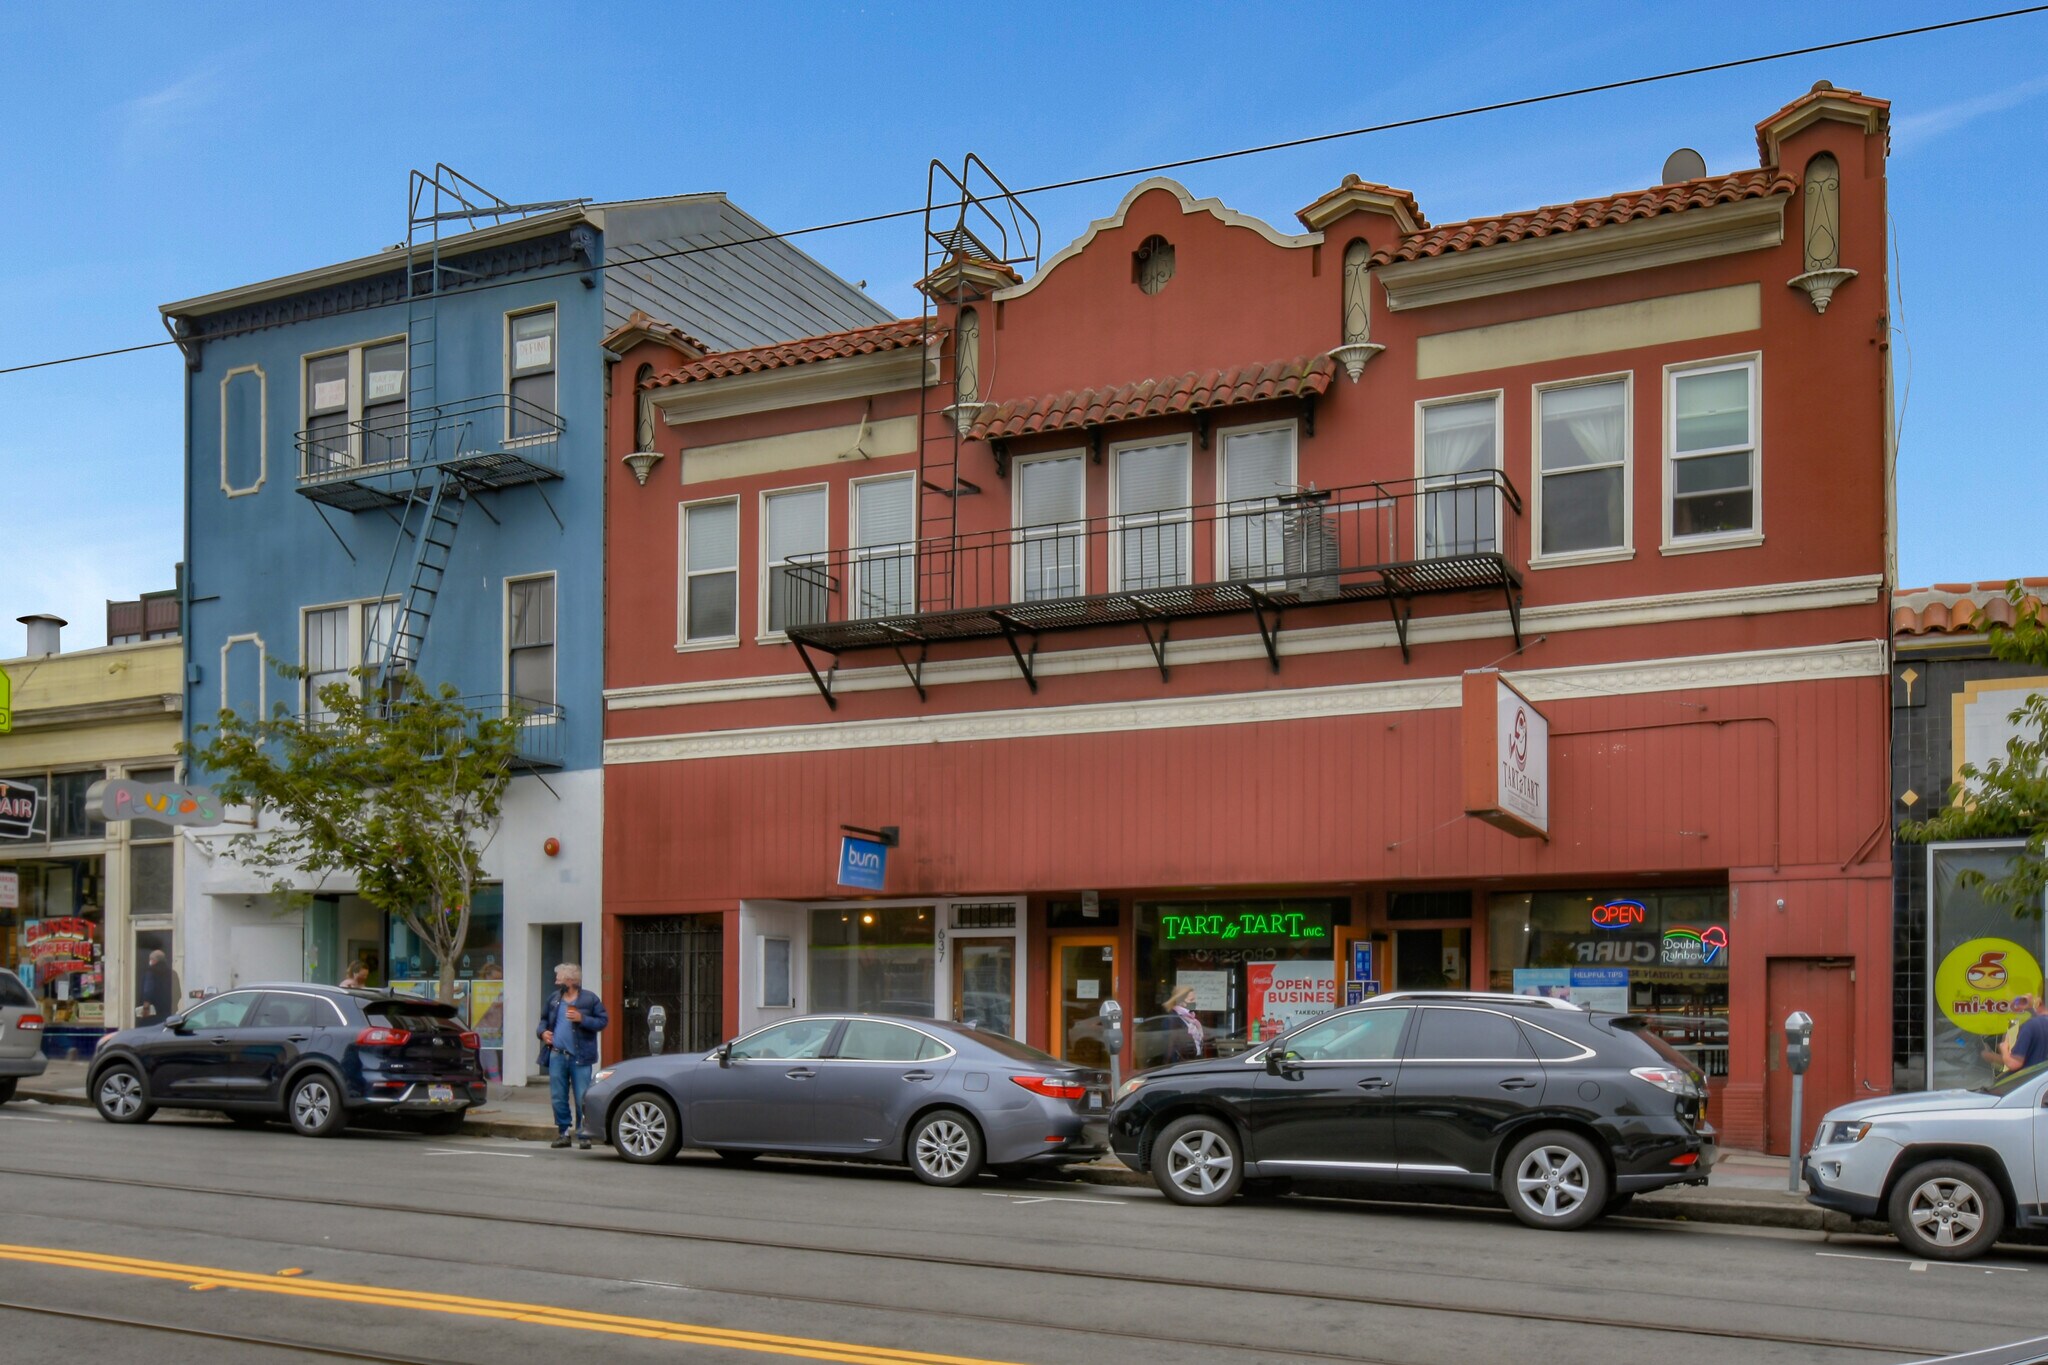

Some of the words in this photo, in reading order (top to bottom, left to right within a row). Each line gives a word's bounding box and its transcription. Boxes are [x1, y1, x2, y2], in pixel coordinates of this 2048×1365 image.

[849, 844, 880, 869] burn
[1592, 906, 1644, 923] OPEN
[26, 916, 96, 947] SUNSET
[1162, 915, 1223, 940] TART
[1222, 922, 1241, 939] to
[1240, 913, 1304, 938] TART
[1303, 927, 1325, 937] INC.
[937, 928, 946, 963] 637
[1663, 938, 1700, 950] Double
[1661, 951, 1706, 963] Rainbow
[1275, 980, 1312, 990] OPEN
[1317, 980, 1335, 990] FO
[1268, 992, 1335, 1003] BUSINES
